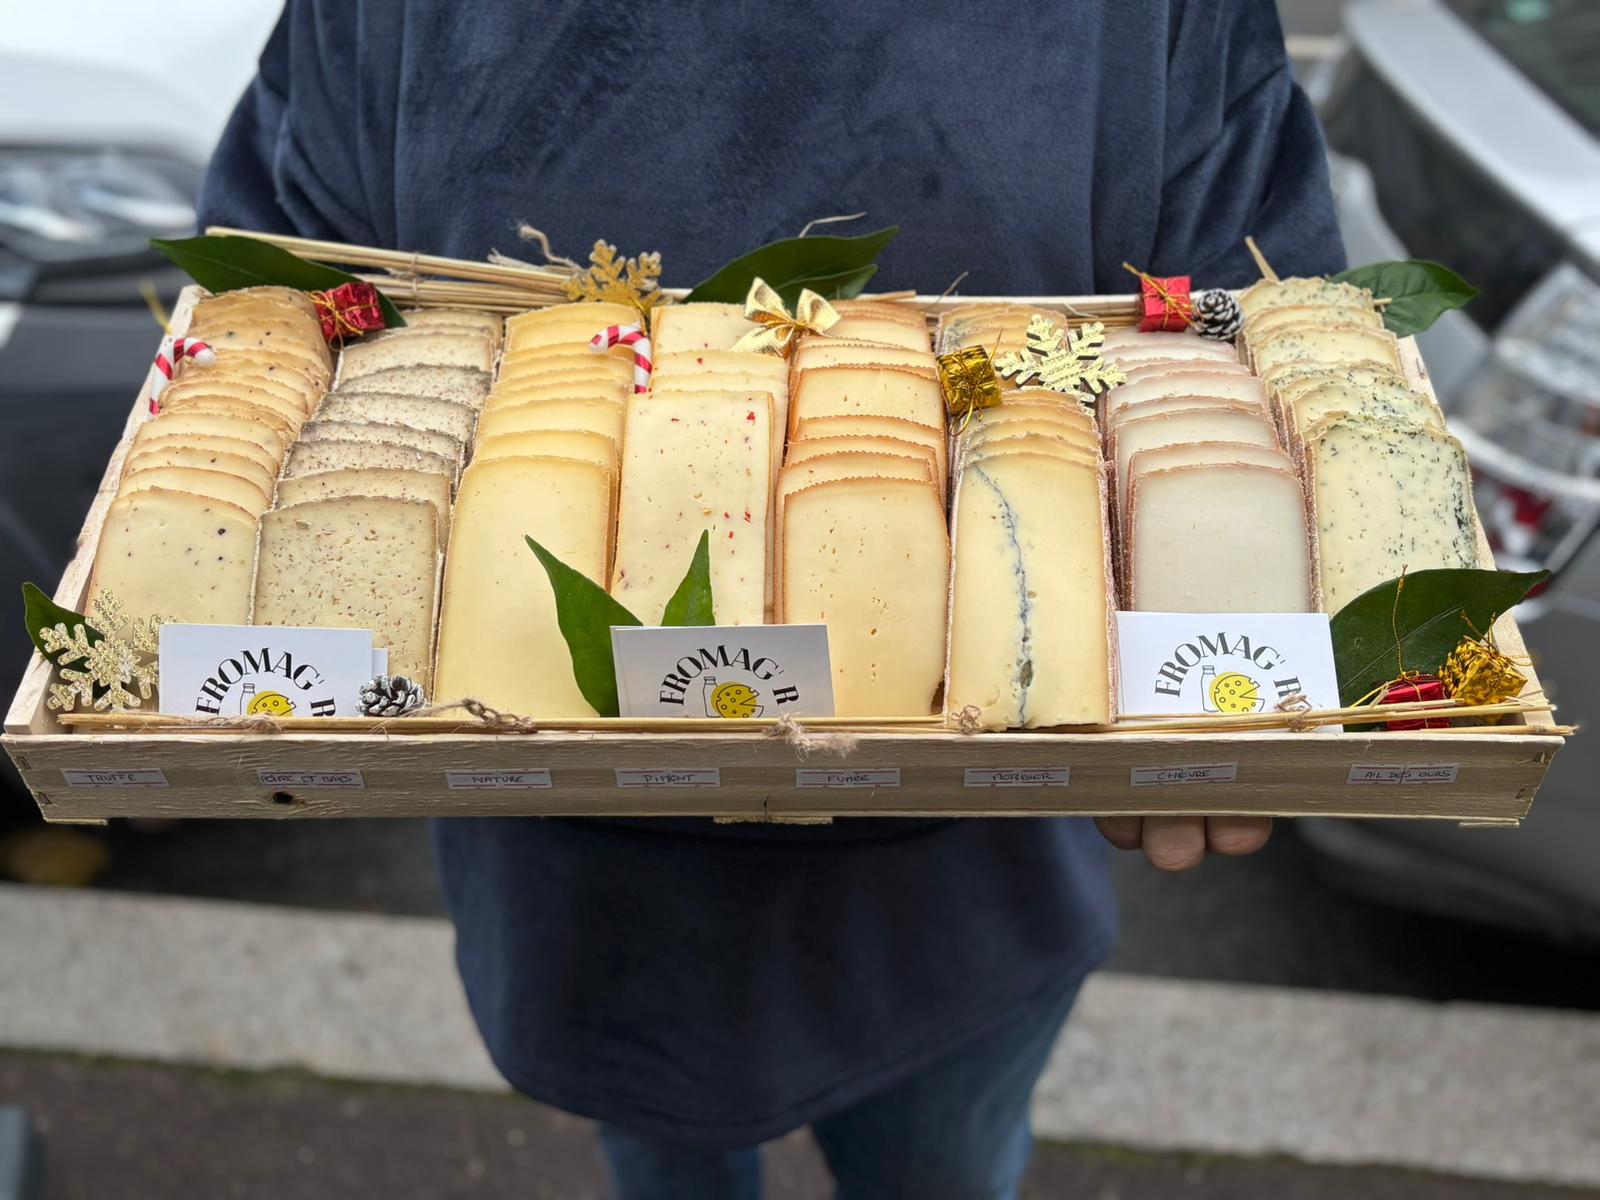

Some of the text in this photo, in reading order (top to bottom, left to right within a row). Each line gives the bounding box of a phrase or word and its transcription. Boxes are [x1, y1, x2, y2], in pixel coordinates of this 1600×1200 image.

[85, 773, 137, 783] TRUFFE
[300, 774, 317, 783] ET
[642, 773, 695, 783] PIMENT
[991, 772, 1055, 781] MORBIER
[1363, 770, 1382, 779] AIL
[1418, 769, 1451, 778] OURS
[471, 775, 525, 784] NATURE
